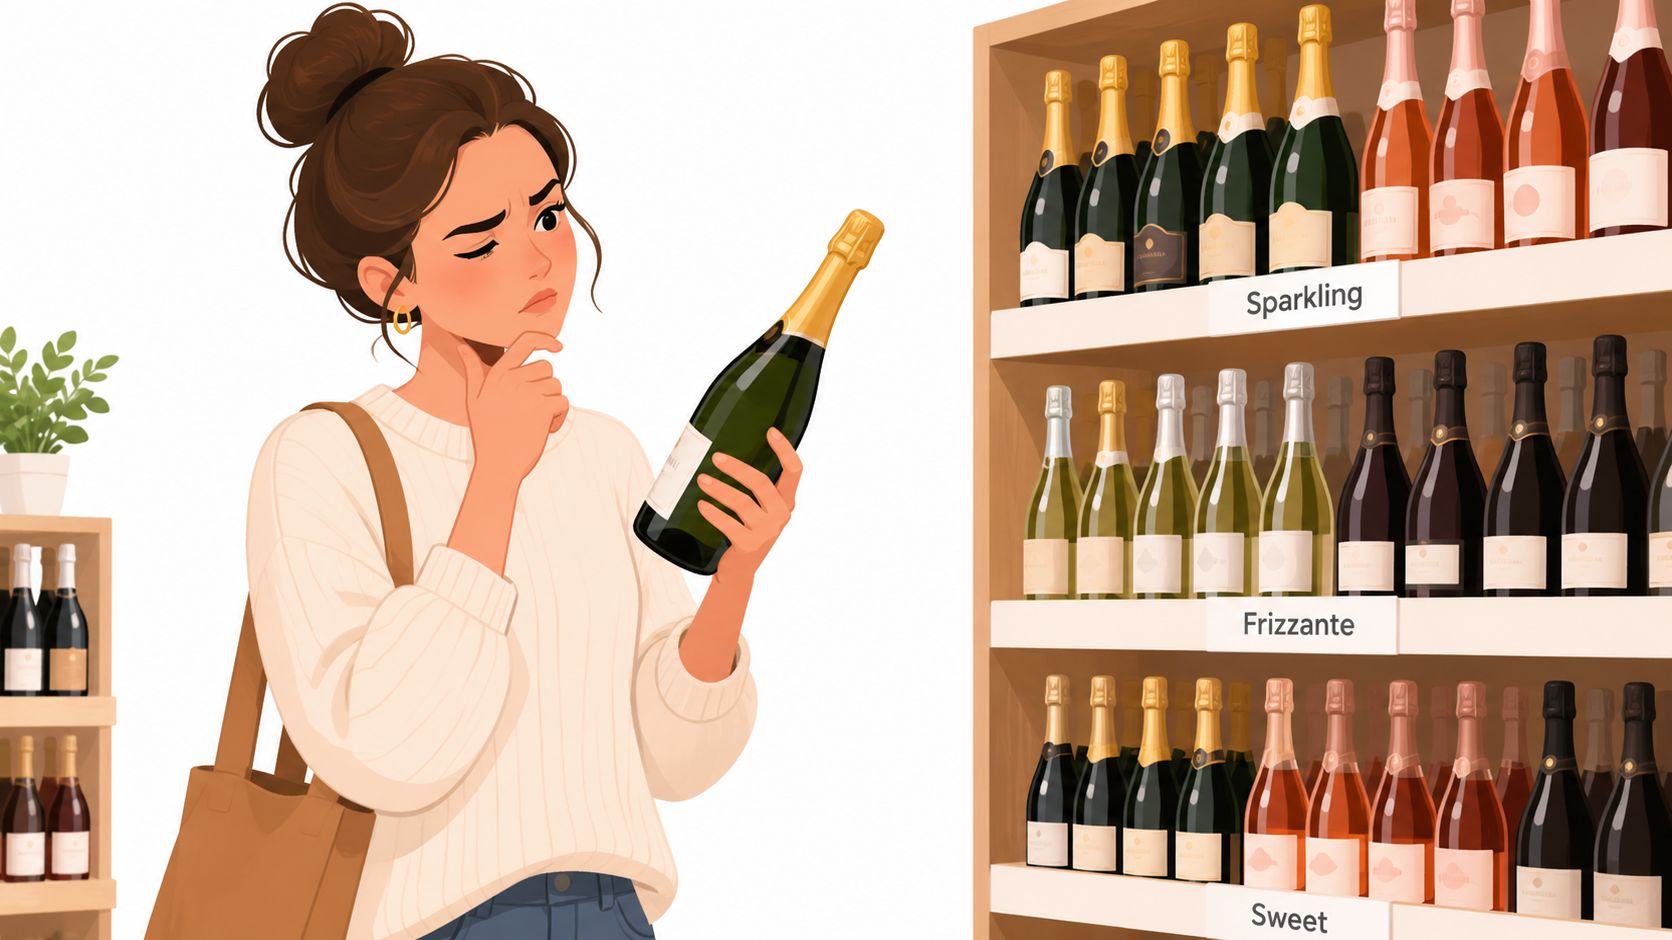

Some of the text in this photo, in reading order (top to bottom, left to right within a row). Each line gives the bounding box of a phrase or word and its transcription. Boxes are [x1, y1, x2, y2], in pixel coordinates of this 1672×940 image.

[1247, 283, 1362, 319] Sparkling
[1244, 612, 1354, 636] Frizzante
[1251, 903, 1328, 934] Sweet
